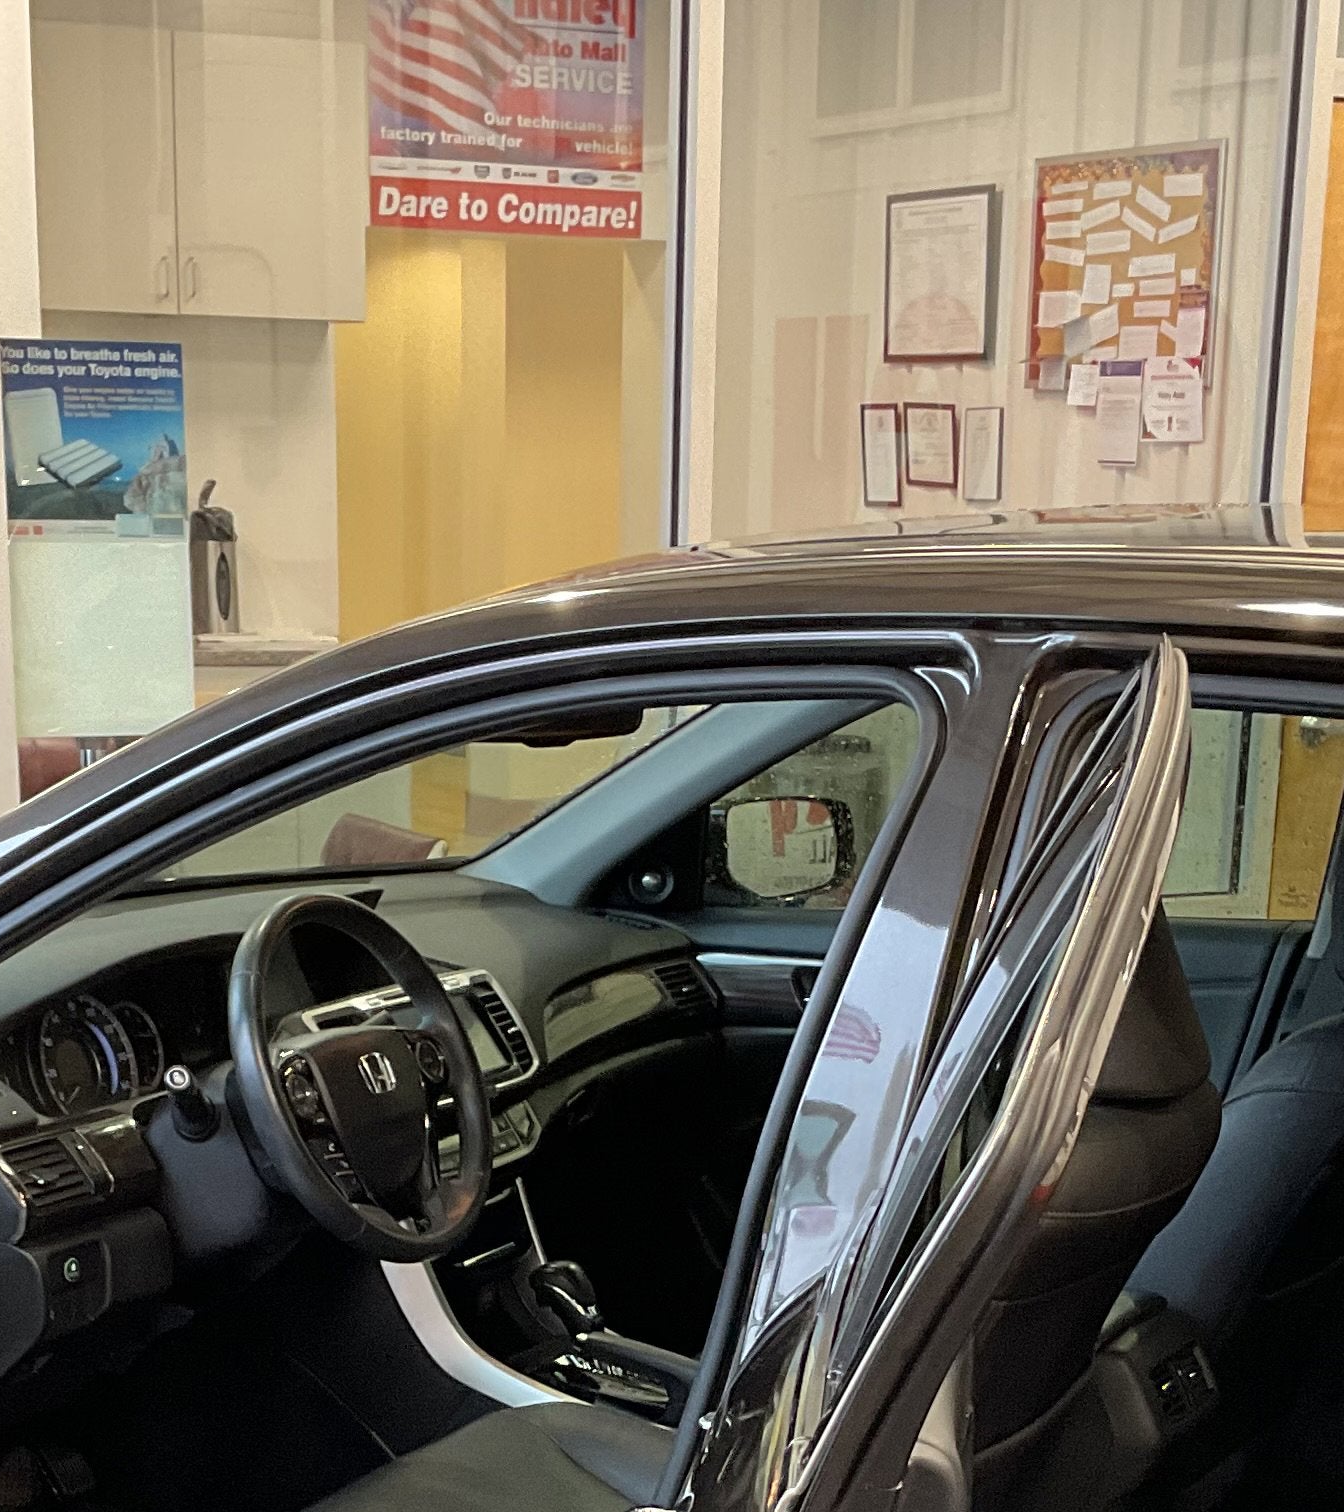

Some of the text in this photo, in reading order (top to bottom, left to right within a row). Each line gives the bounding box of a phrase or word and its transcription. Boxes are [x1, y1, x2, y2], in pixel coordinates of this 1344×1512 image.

[580, 40, 626, 62] Mall
[513, 63, 633, 95] SERVICE
[484, 112, 511, 127] Our
[517, 113, 604, 133] technicians
[381, 126, 633, 156] factory trained for vehicle!
[378, 185, 638, 232] Dare to Compare!
[27, 346, 52, 360] like
[54, 347, 68, 361] to
[70, 348, 121, 362] breathe
[123, 349, 156, 363] fresh
[22, 362, 54, 376] does
[57, 364, 87, 378] your
[89, 363, 132, 379] Toyota
